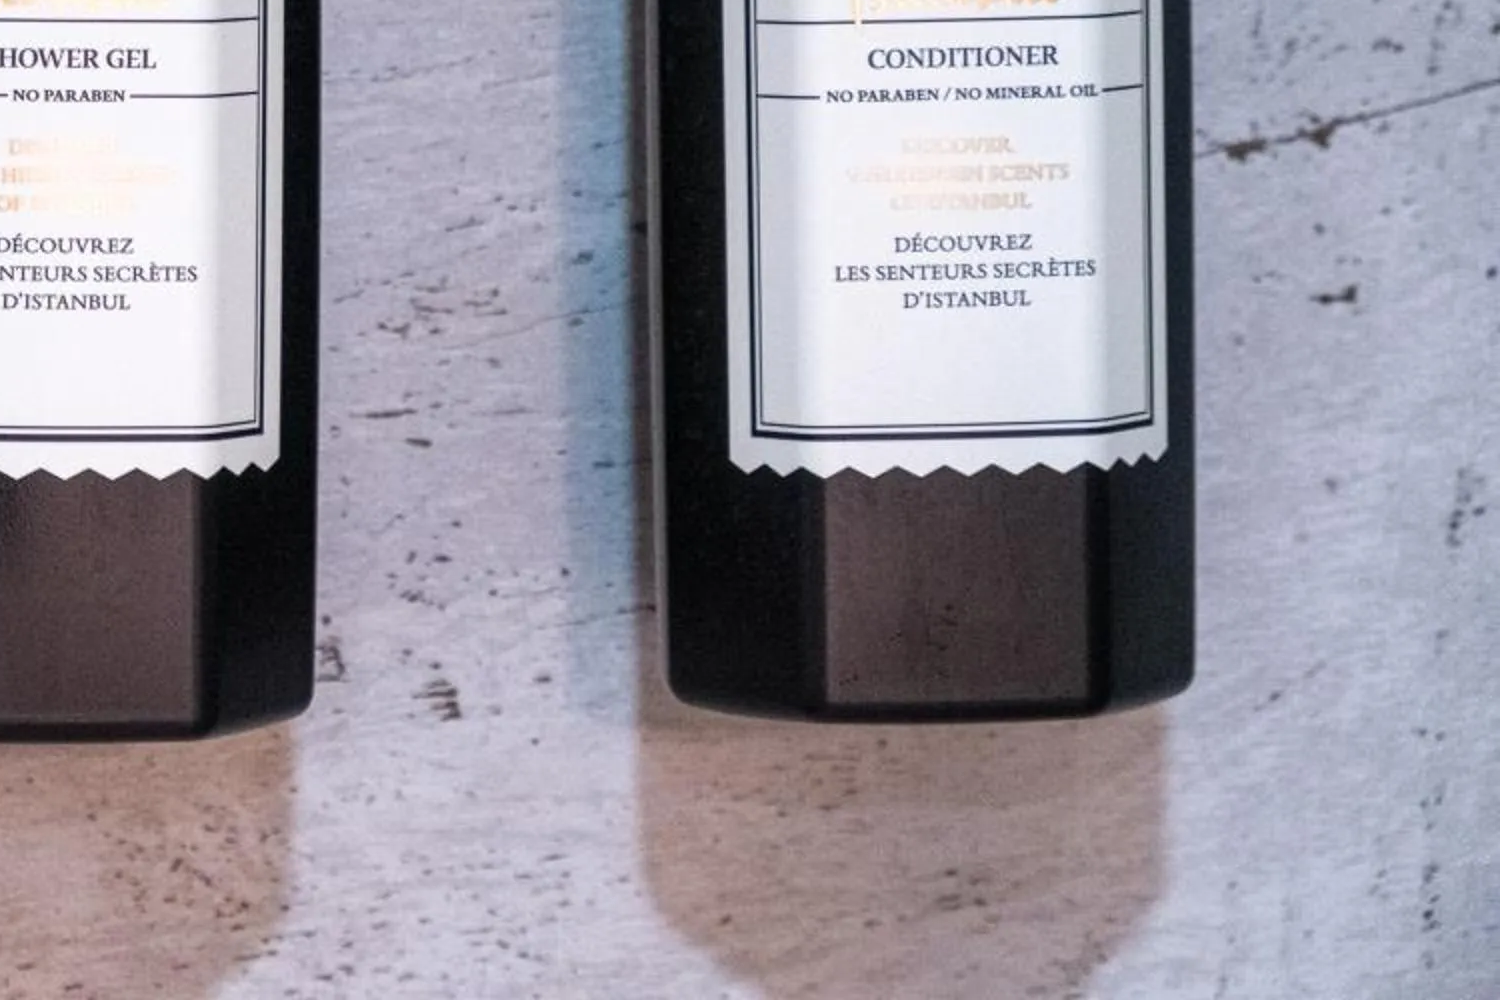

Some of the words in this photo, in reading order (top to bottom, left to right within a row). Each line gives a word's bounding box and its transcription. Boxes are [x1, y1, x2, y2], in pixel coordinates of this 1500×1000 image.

[106, 48, 156, 69] GEL
[868, 45, 1058, 69] CONDITIONER
[13, 89, 39, 102] NO
[44, 90, 125, 102] PARABEN
[827, 90, 854, 103] NO
[858, 89, 939, 102] PARABEN
[955, 88, 982, 100] NO
[986, 85, 1066, 99] MINERAL
[1070, 83, 1101, 97] OIL
[895, 233, 1032, 253] DÉCOUVREZ
[93, 262, 198, 282] SECRÈTES
[836, 266, 870, 282] LES
[876, 264, 987, 280] SENTEURS
[993, 257, 1096, 278] SECRÈTES
[2, 292, 130, 310] D'ISTANBUL
[904, 290, 1031, 308] D'ISTANBUL
